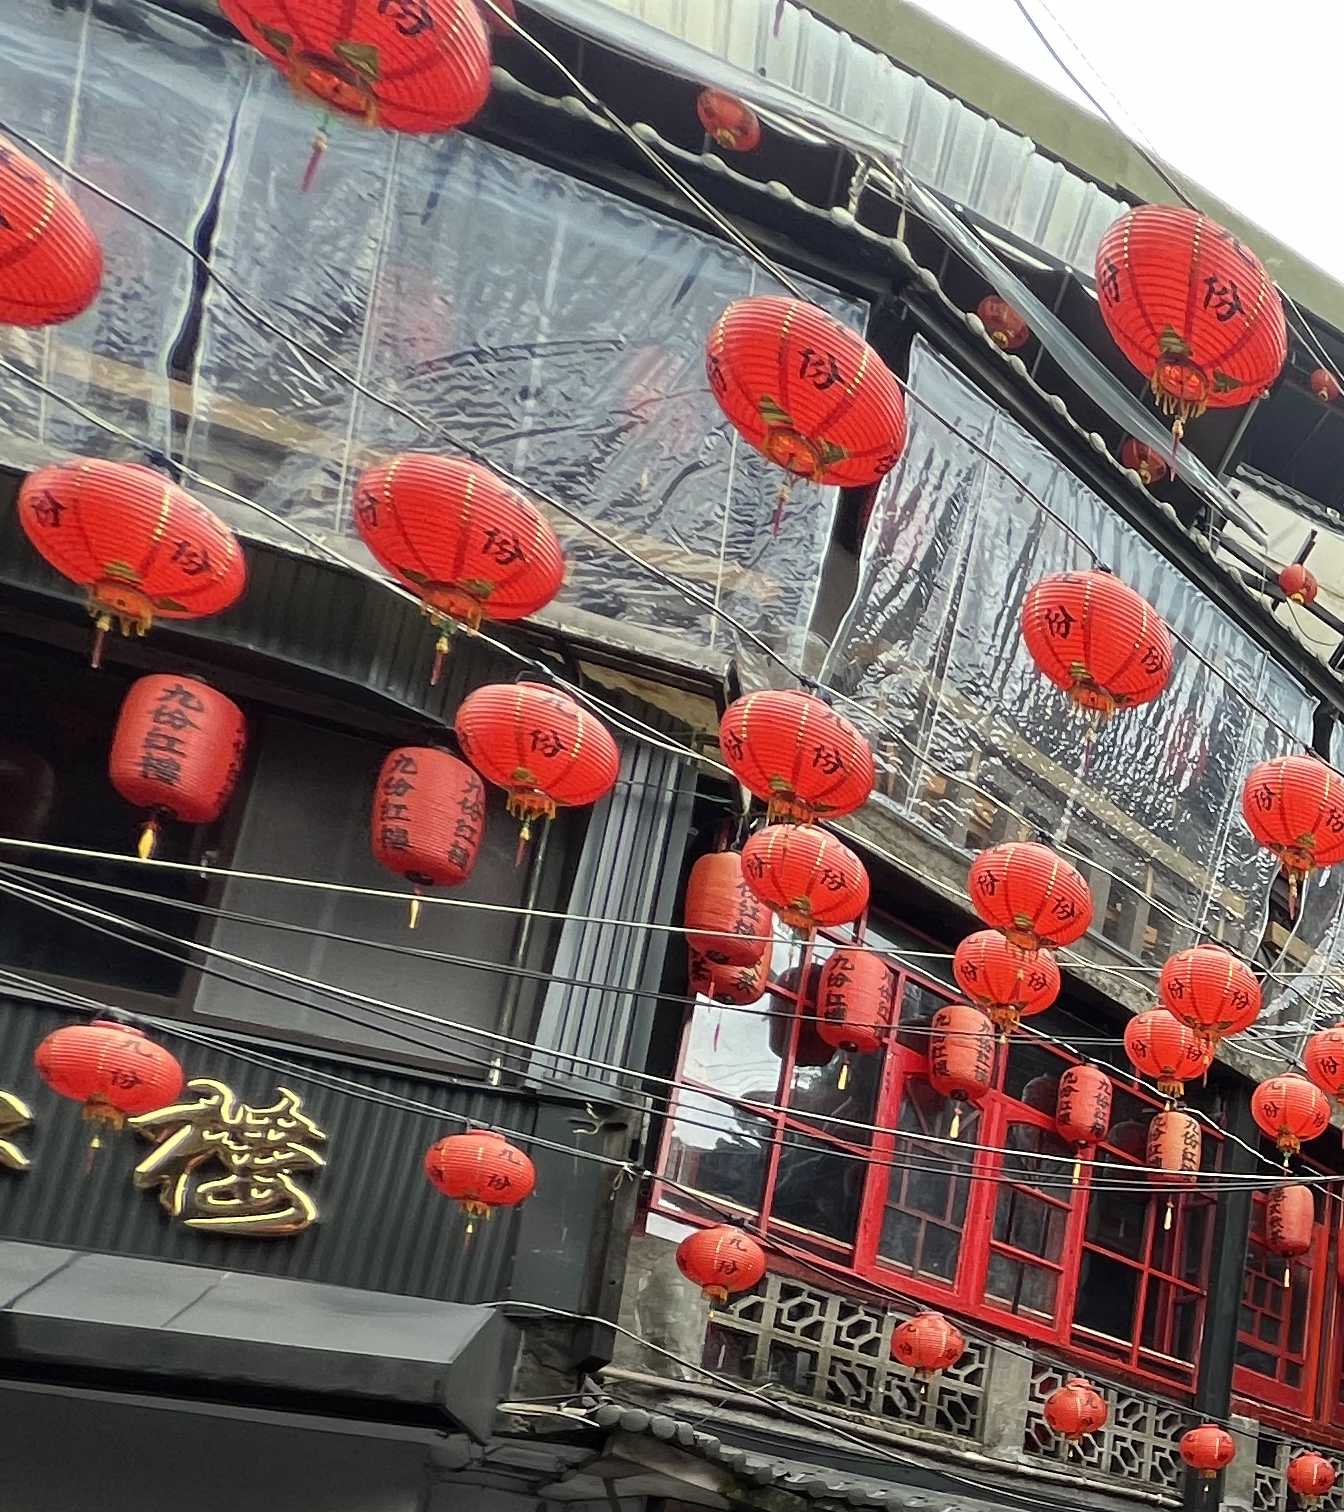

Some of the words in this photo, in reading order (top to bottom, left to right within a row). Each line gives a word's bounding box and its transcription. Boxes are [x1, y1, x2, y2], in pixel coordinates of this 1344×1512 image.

[1203, 276, 1245, 323] 份
[798, 345, 842, 390] 份
[481, 525, 524, 566] 份
[1044, 606, 1076, 640] 份
[811, 743, 846, 776] 份
[1253, 784, 1275, 811] 份
